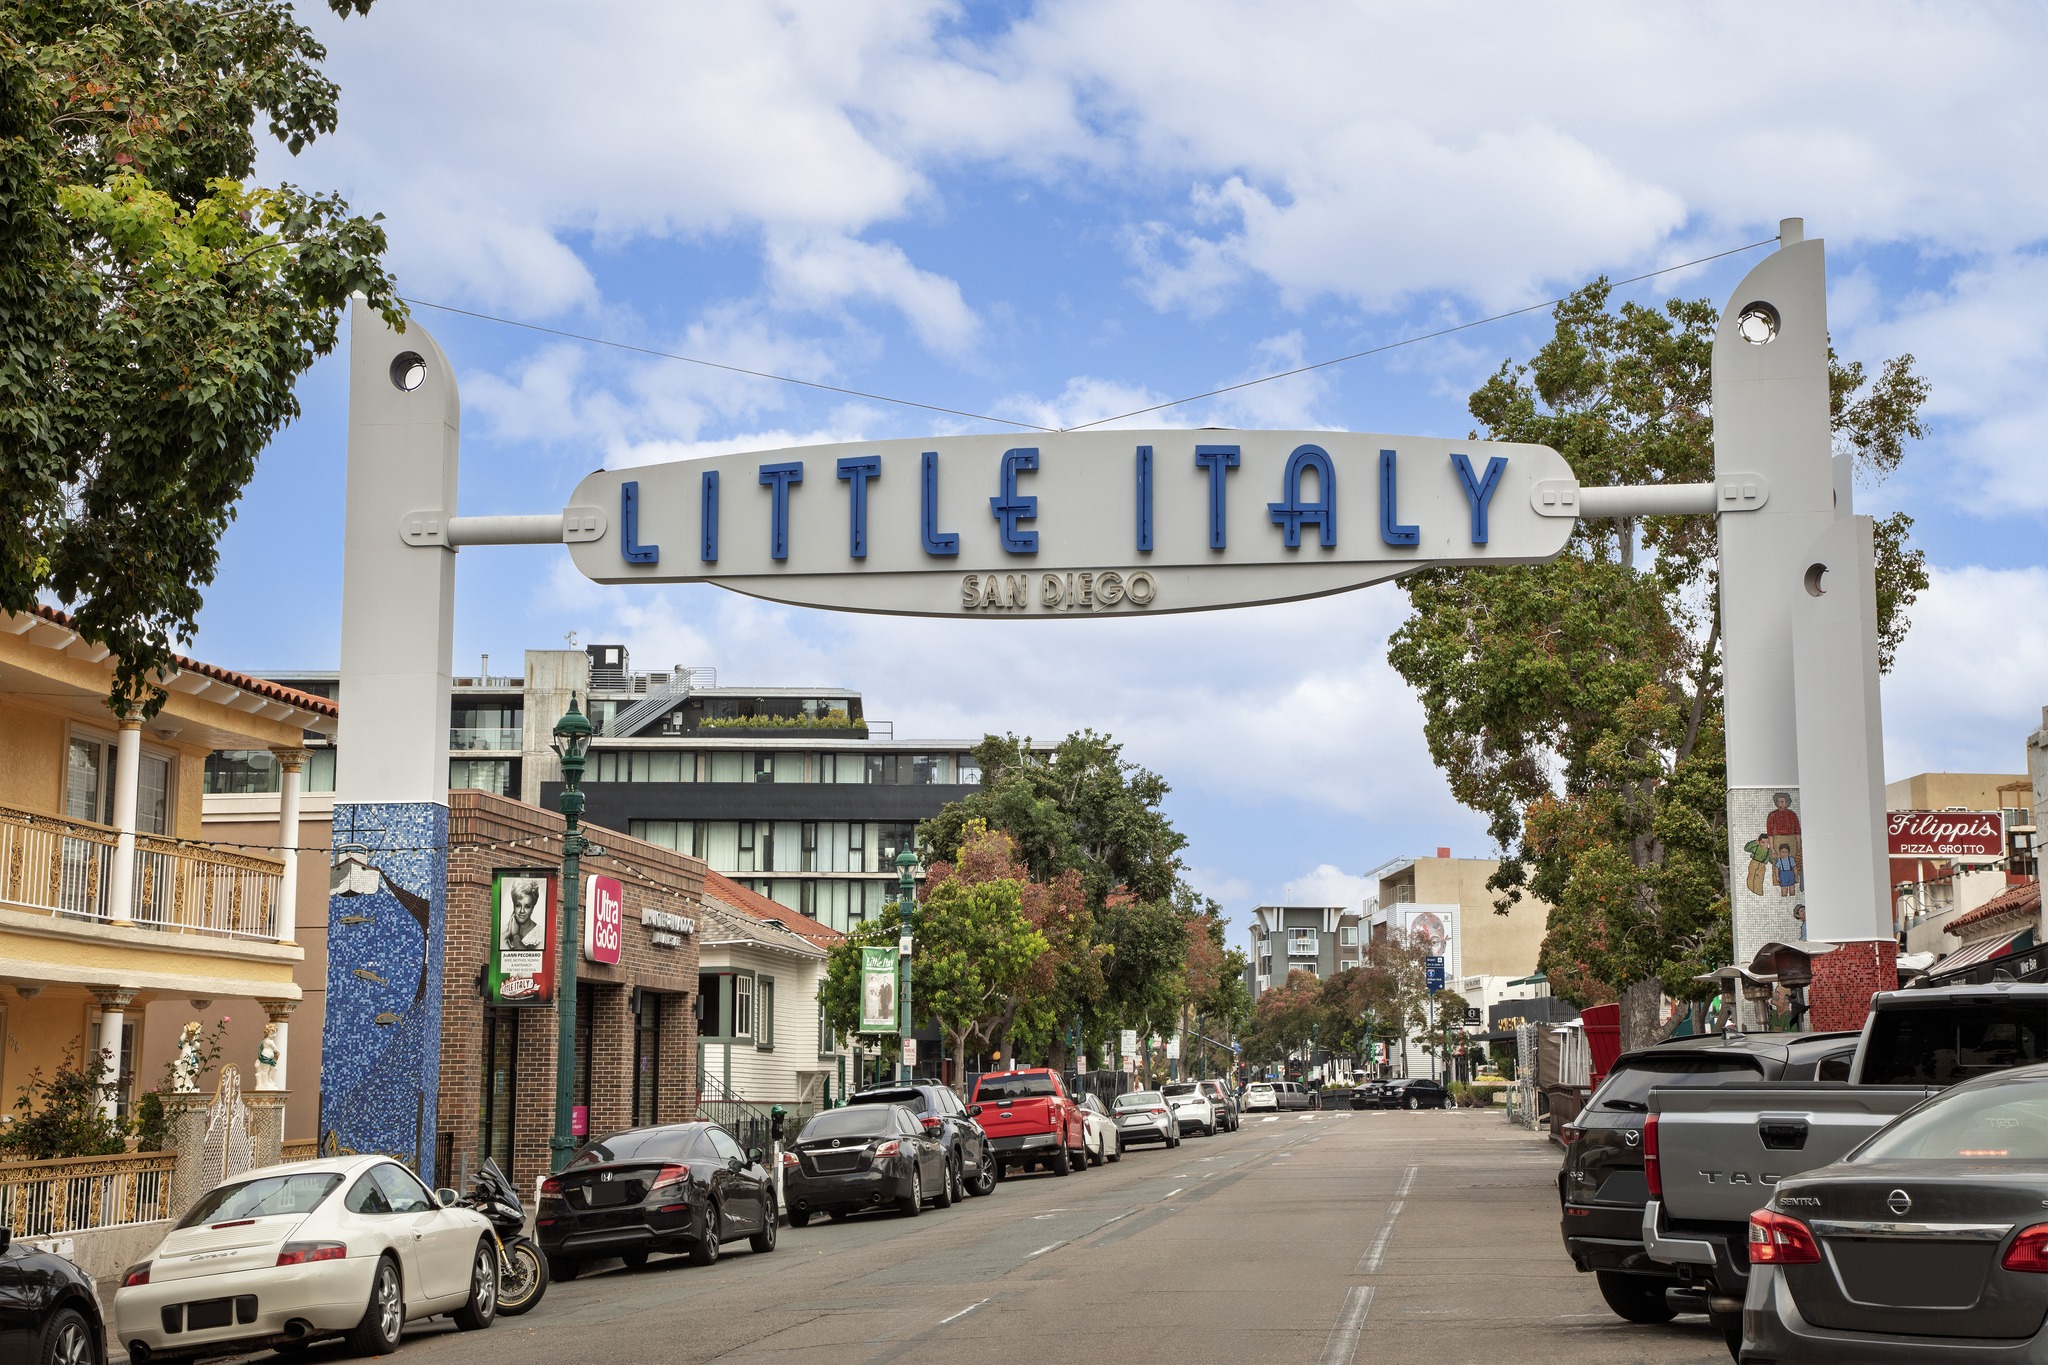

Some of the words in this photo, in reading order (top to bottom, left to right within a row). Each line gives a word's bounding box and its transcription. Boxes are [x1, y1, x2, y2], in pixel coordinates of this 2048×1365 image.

[621, 447, 1040, 565] LITTLE
[1136, 444, 1509, 553] ITALY
[961, 573, 1029, 609] SAN
[1040, 570, 1158, 608] DIEGO
[1888, 813, 1998, 843] Filippi's
[1900, 844, 1934, 853] PIZZA
[1938, 844, 1985, 854] GROTTO
[596, 888, 619, 925] Ultra
[595, 921, 618, 951] GoGo
[514, 979, 530, 990] ITALY
[1985, 1117, 2019, 1129] TRD
[1780, 1197, 1821, 1206] SENTRA
